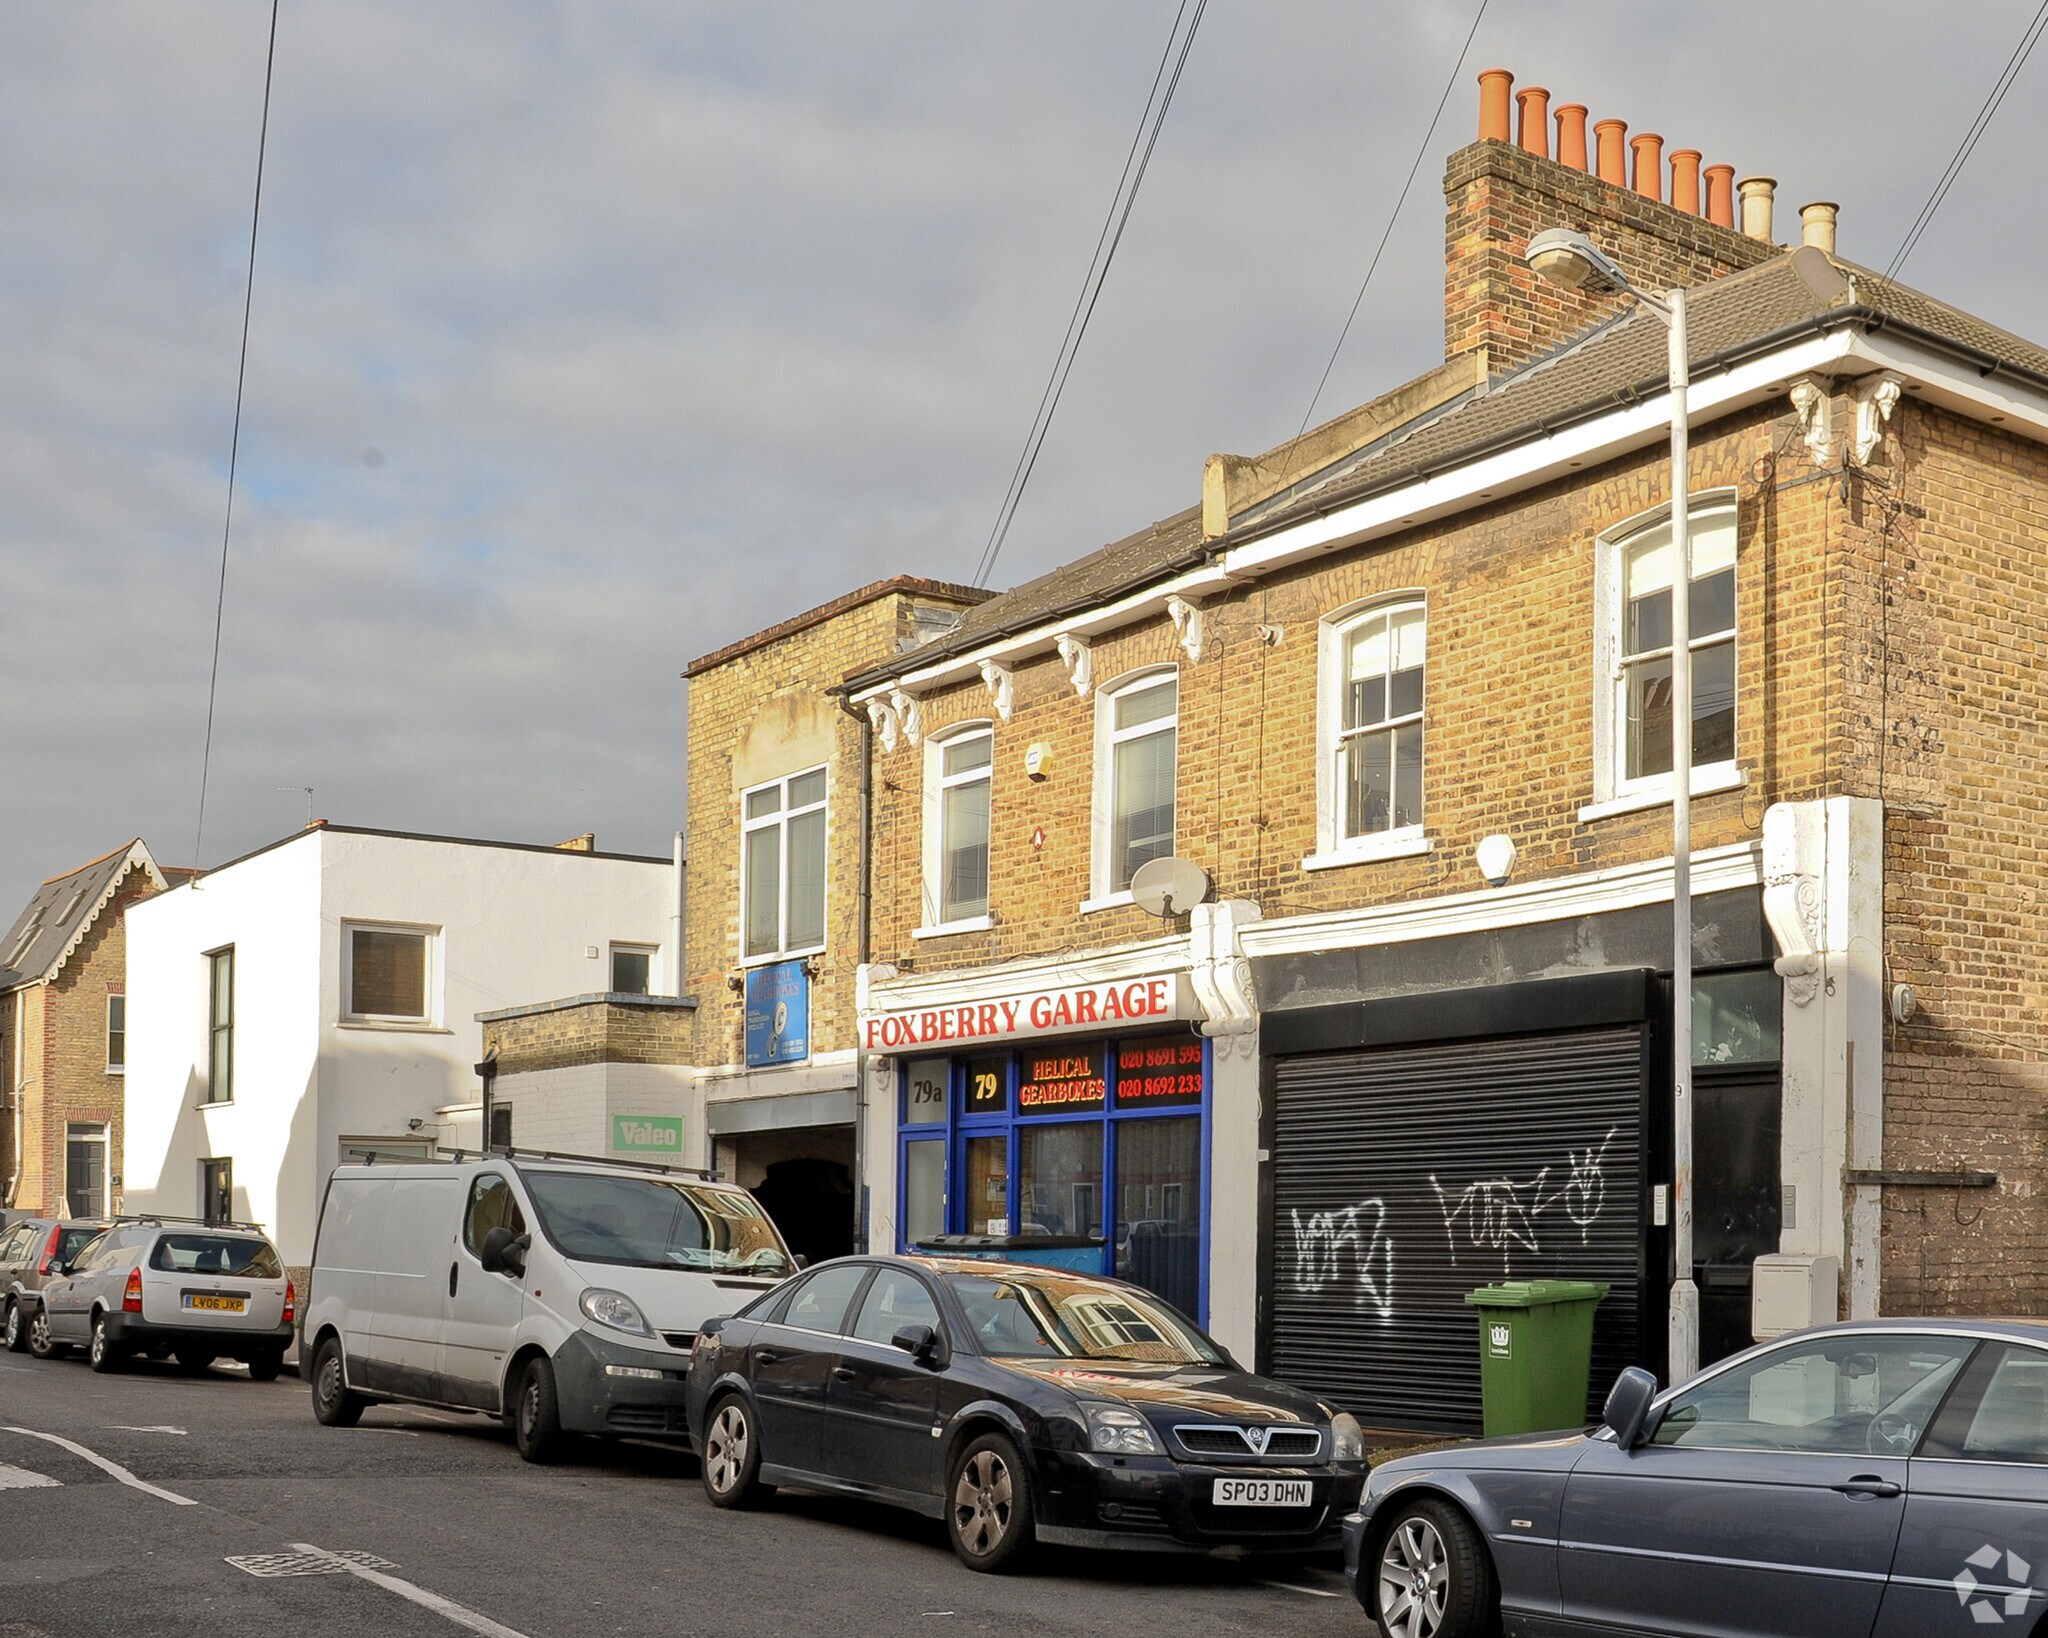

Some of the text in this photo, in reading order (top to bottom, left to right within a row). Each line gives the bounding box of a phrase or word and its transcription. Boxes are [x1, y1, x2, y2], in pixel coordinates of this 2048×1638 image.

[866, 980, 1168, 1049] FOXBERRY GARAGE
[1033, 1056, 1091, 1081] HELICAL
[1121, 1051, 1144, 1069] 020
[1146, 1047, 1176, 1066] 8691
[913, 1080, 942, 1104] 79a
[975, 1073, 997, 1100] 79
[1019, 1078, 1106, 1106] GEARBOXES
[1118, 1078, 1142, 1098] 020
[1144, 1076, 1175, 1096] 8692
[619, 1121, 677, 1146] Valeo
[222, 1298, 244, 1311] JXP
[1222, 1482, 1306, 1503] SP03 DHN
